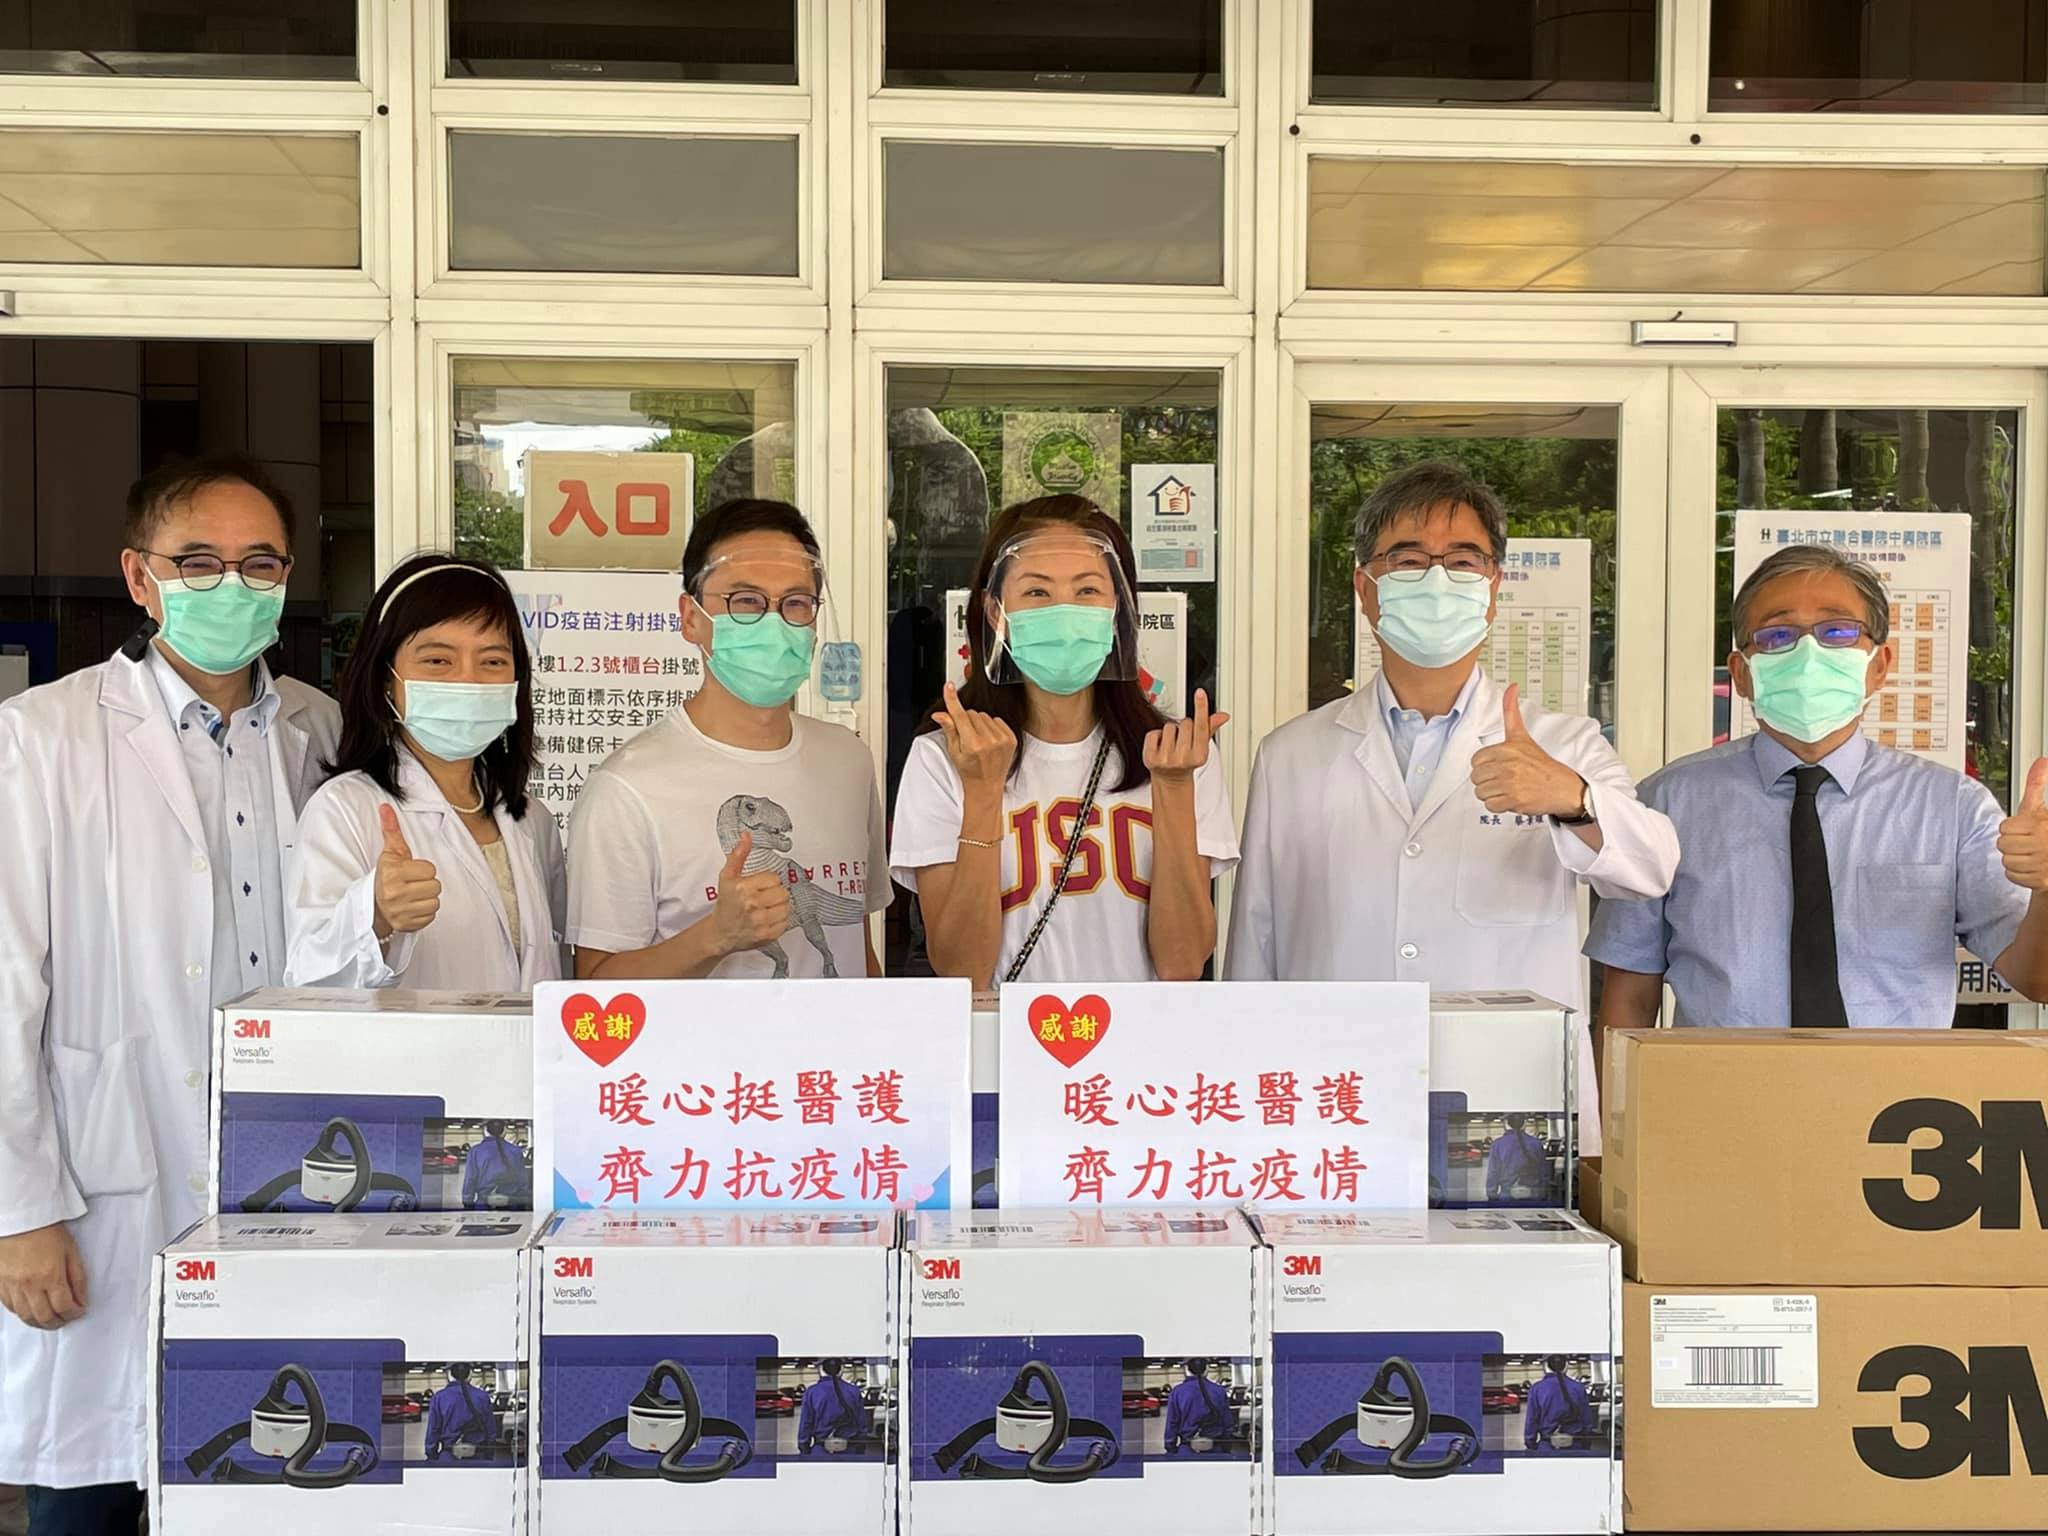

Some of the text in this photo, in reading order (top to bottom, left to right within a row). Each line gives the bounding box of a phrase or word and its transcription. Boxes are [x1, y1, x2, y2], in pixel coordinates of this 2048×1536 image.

[548, 479, 670, 537] 入口
[1137, 613, 1175, 630] 院區
[233, 1019, 270, 1038] 3M
[573, 1014, 633, 1041] 感謝
[1039, 1014, 1098, 1042] 感謝
[233, 1047, 270, 1057] Versaflo
[599, 1070, 911, 1126] 暖心挺醫護
[1063, 1071, 1369, 1126] 暖心挺醫護
[598, 1144, 909, 1203] 齊力抗疫情
[1063, 1145, 1368, 1203] 齊力抗疫情
[176, 1260, 215, 1280] 3M
[554, 1257, 592, 1277] 3M
[923, 1259, 960, 1279] 3M
[1283, 1256, 1321, 1275] 3M
[176, 1290, 215, 1300] Versaflo
[553, 1286, 592, 1297] Versaflo
[922, 1288, 960, 1299] Versaflo
[1283, 1284, 1321, 1295] Versaflo
